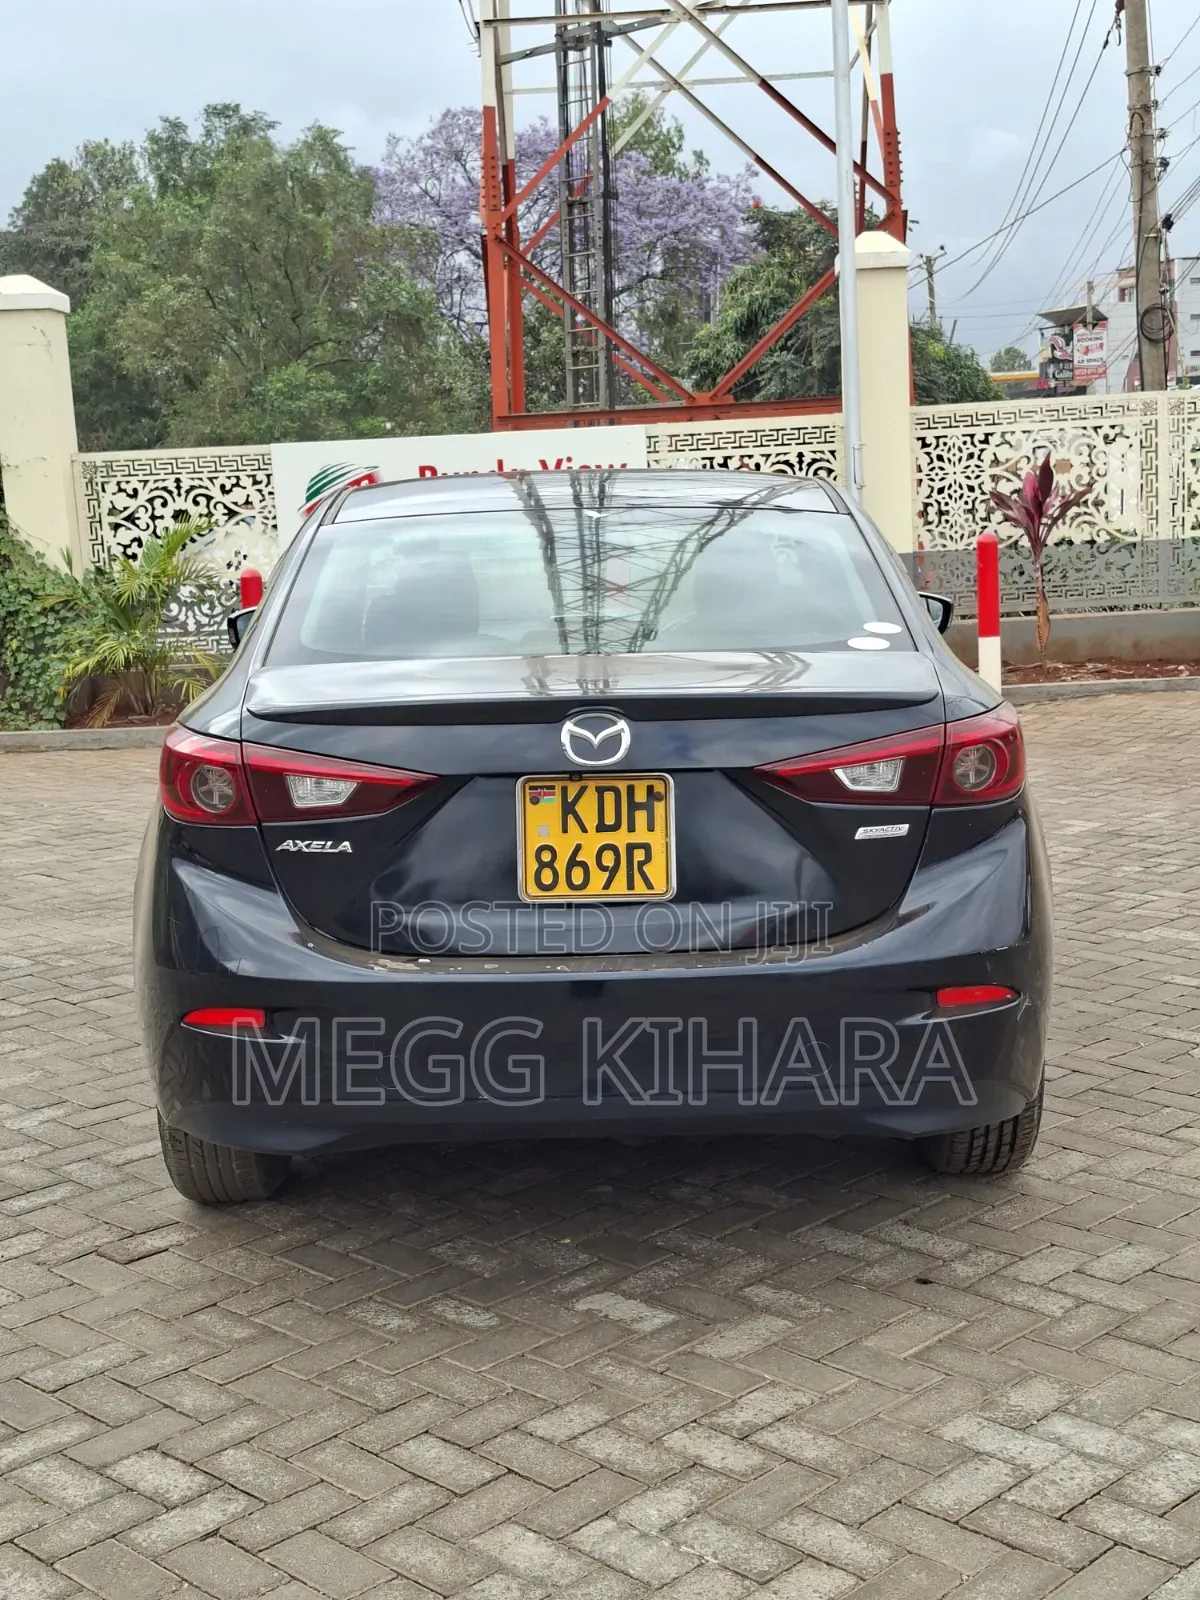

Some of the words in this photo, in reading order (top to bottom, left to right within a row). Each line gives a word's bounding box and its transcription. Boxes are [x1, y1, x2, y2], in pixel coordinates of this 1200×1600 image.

[560, 784, 656, 834] KDH
[274, 839, 353, 853] AXELA
[533, 842, 656, 892] 869R
